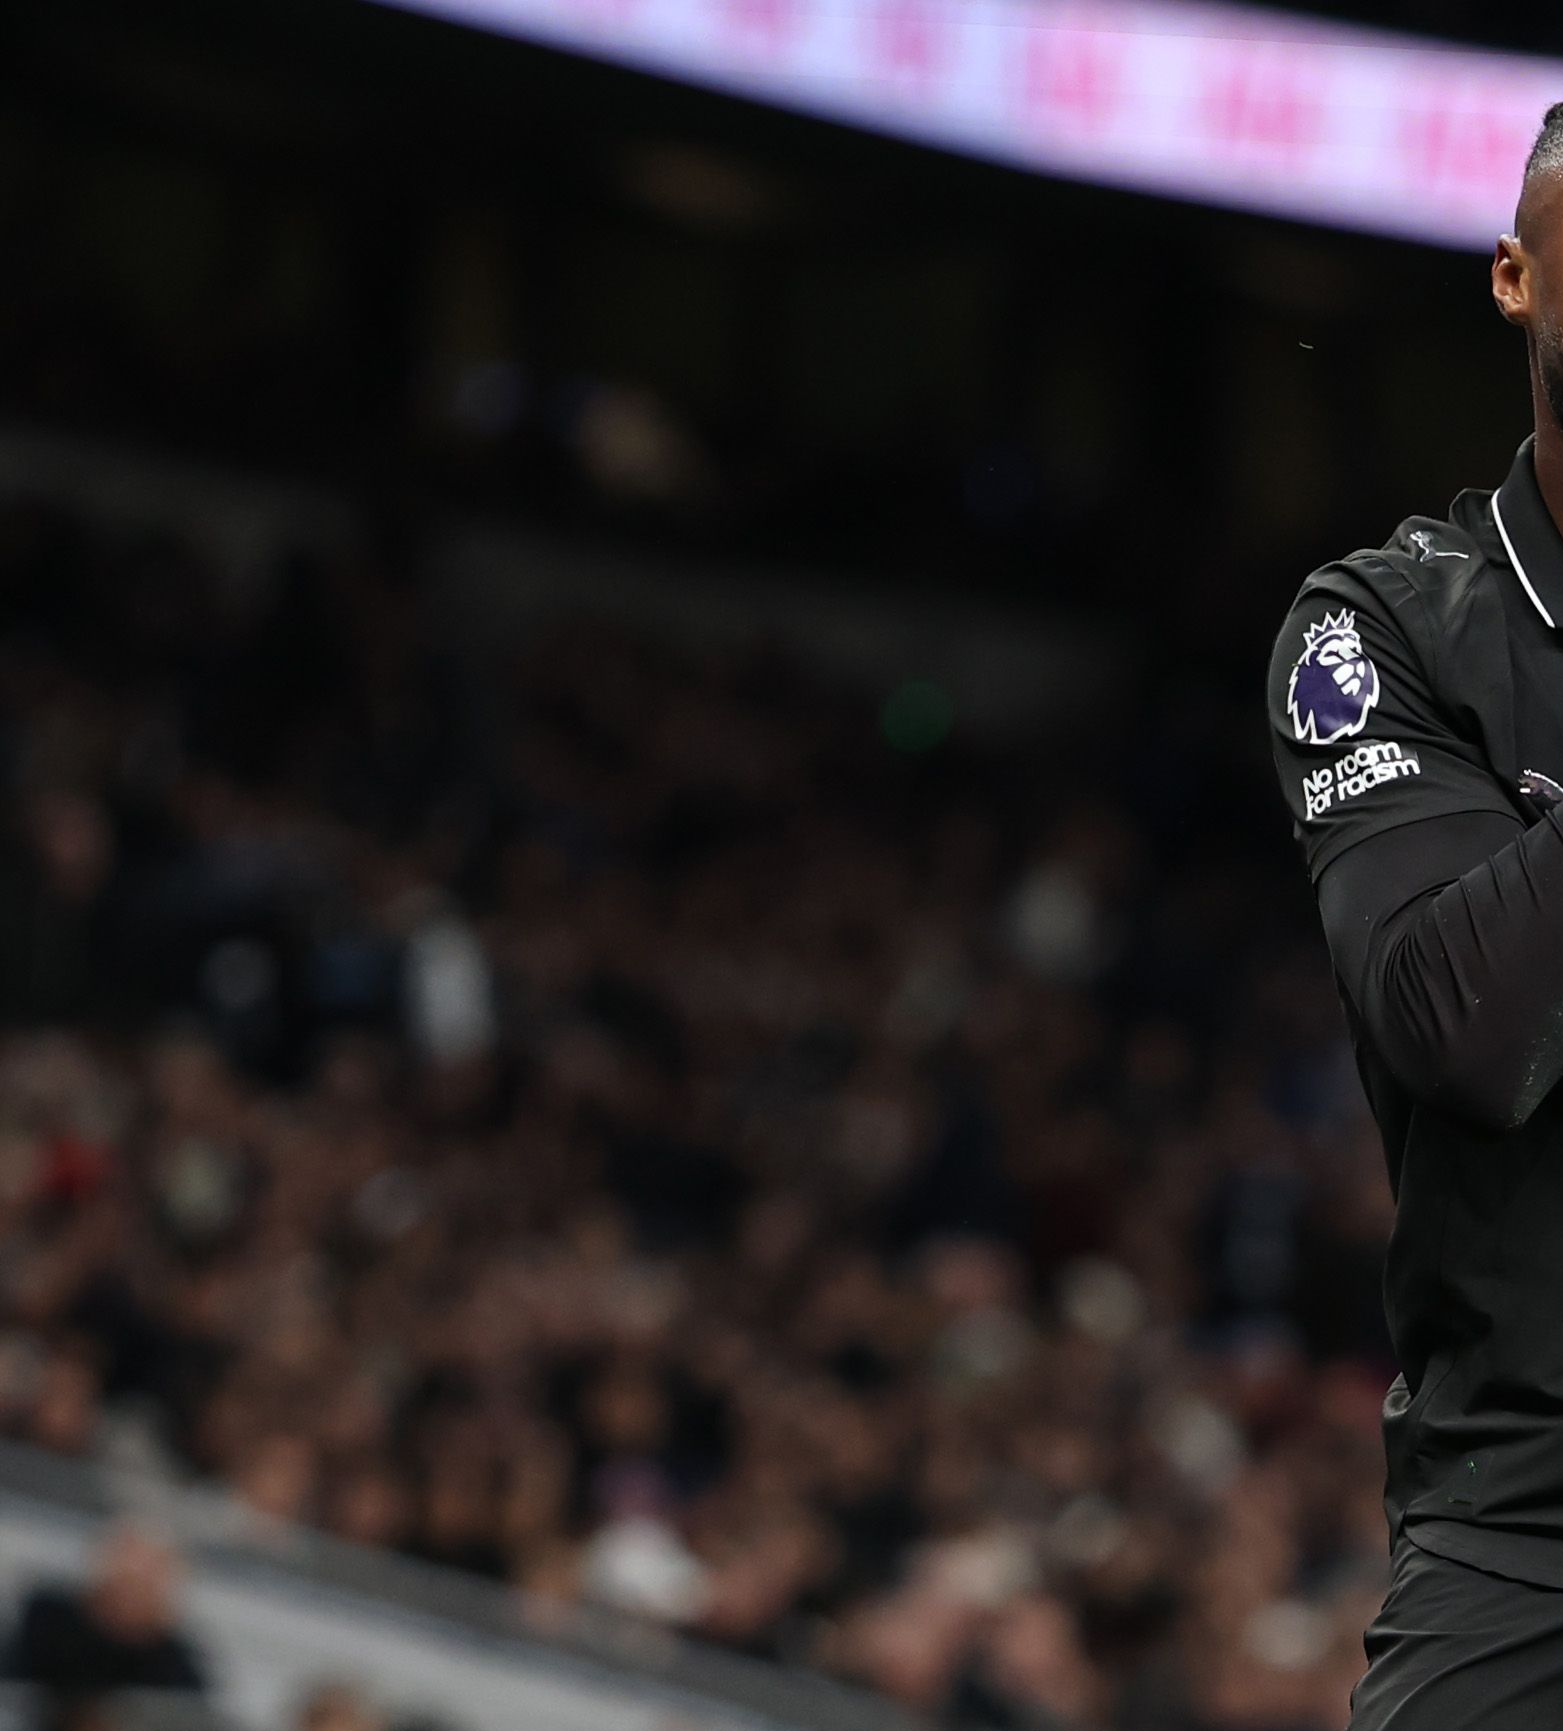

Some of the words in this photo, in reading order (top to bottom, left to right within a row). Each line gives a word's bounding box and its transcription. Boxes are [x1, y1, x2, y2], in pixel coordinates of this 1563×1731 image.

[1302, 768, 1333, 796] No
[1335, 741, 1402, 781] room
[1306, 786, 1334, 821] for
[1337, 759, 1421, 801] racism
